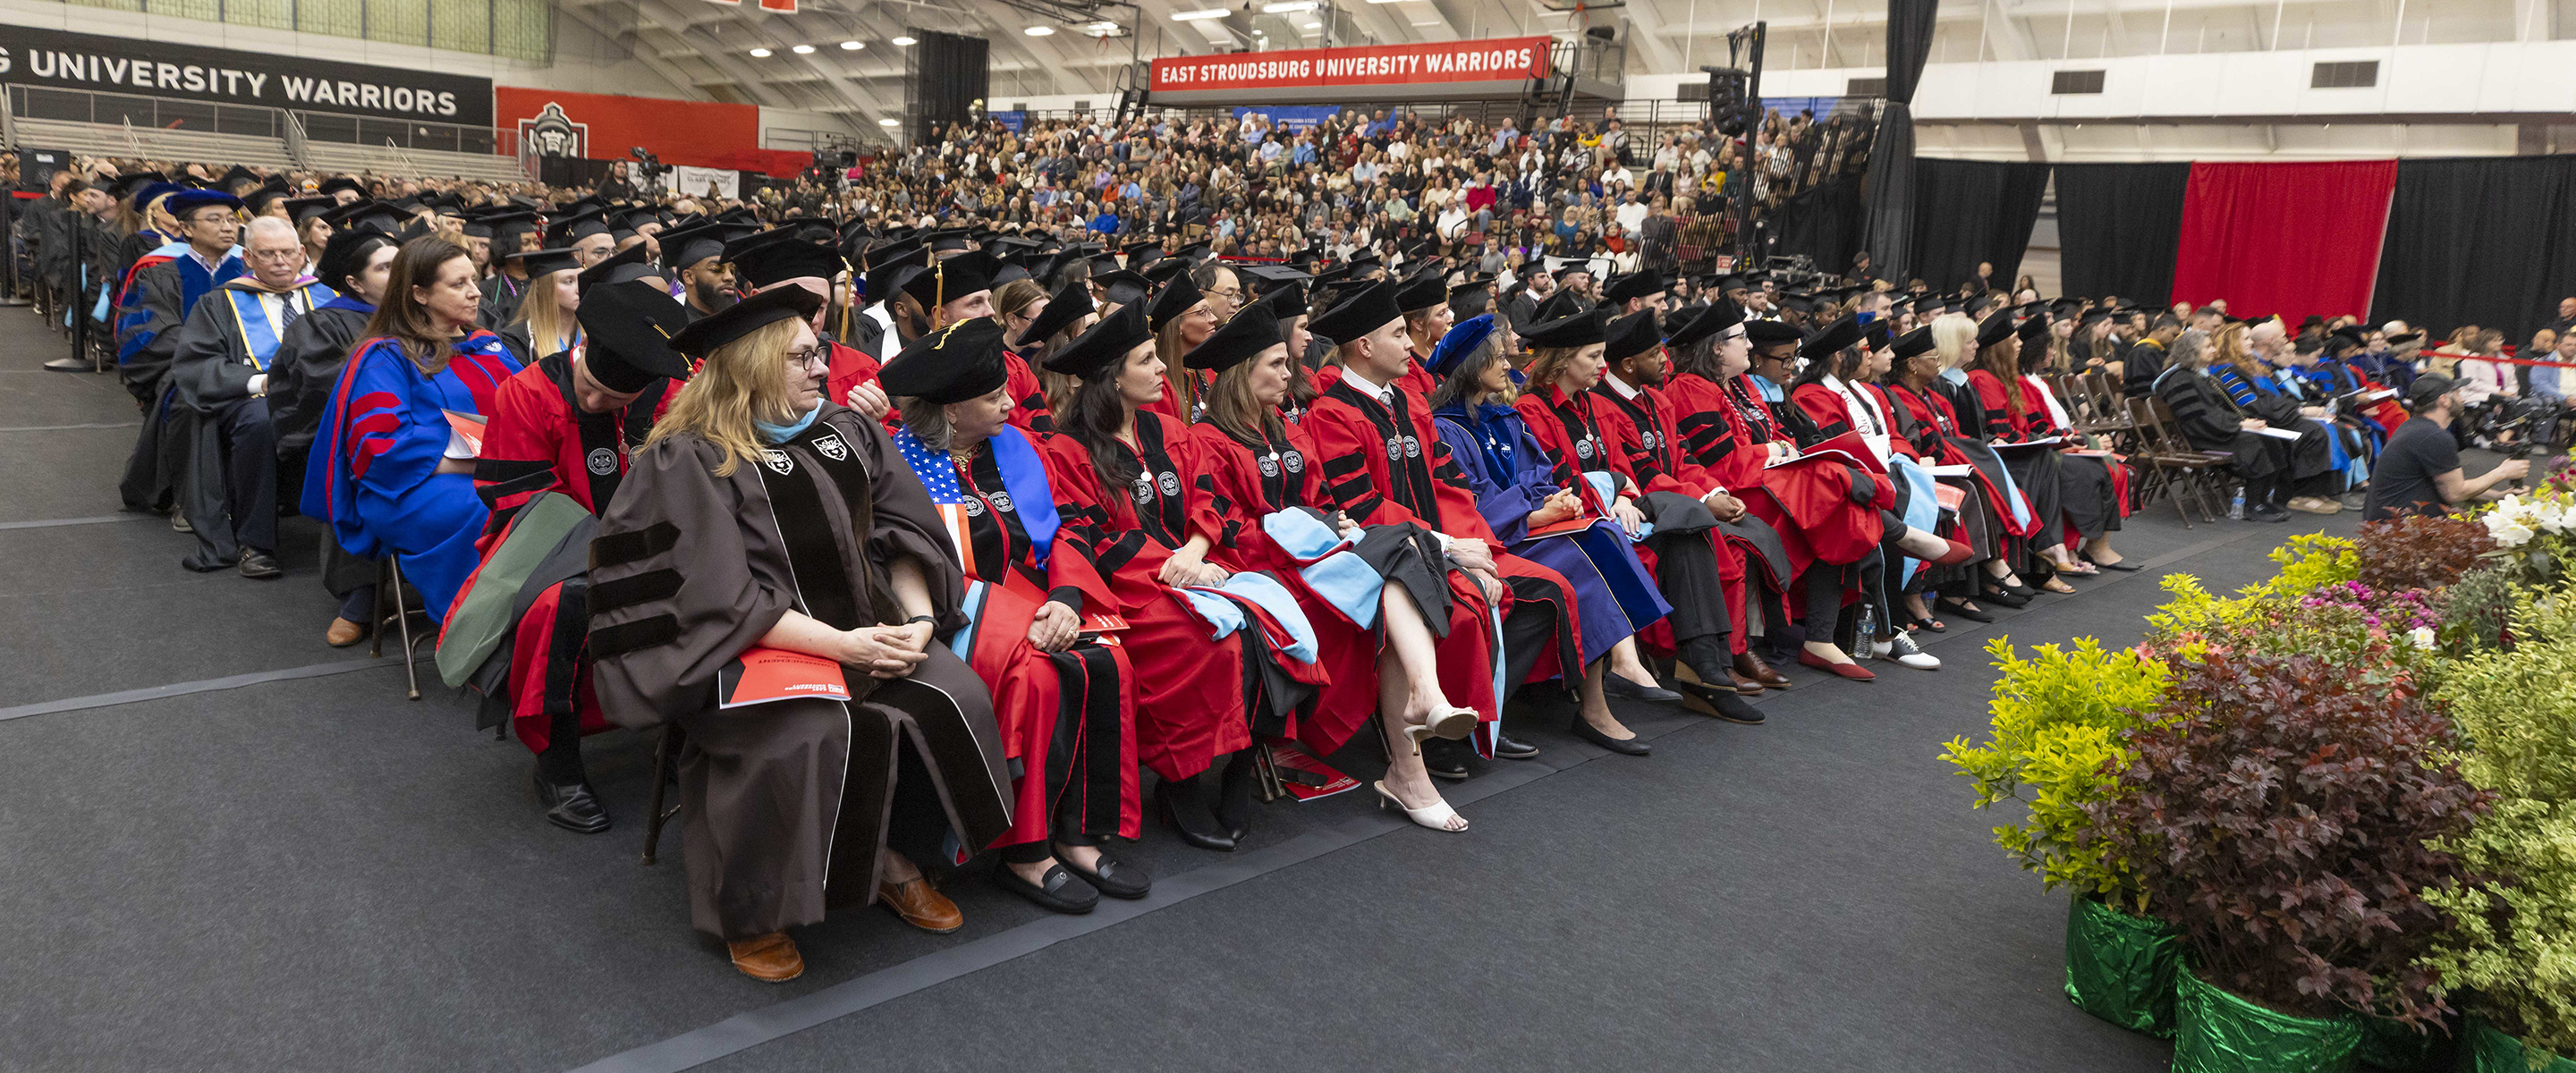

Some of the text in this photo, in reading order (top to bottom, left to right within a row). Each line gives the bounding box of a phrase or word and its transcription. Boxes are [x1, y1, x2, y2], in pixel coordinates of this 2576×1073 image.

[30, 49, 267, 98] UNIVERSITY
[281, 74, 458, 116] WARRIORS
[1161, 47, 1531, 83] EAST STROUDSBURG UNIVERSITY WARRIORS
